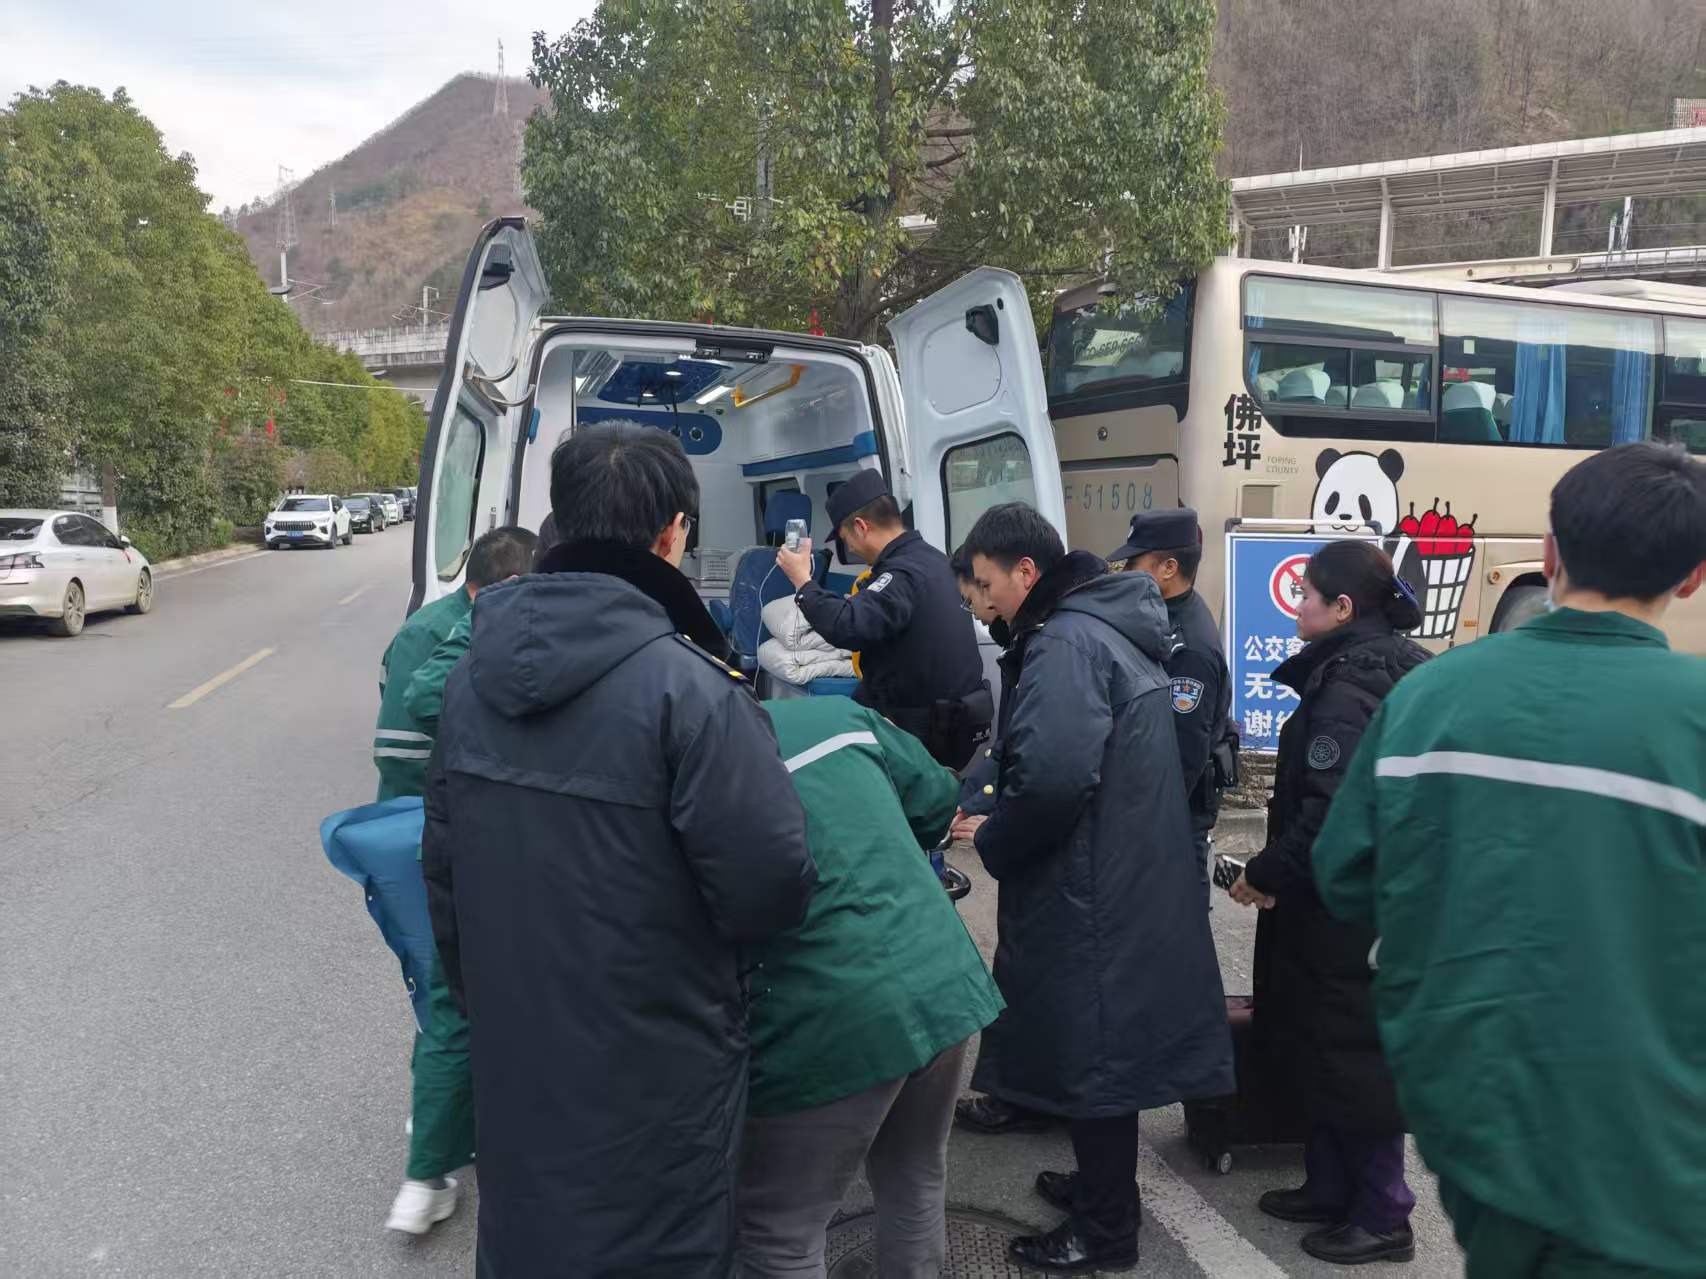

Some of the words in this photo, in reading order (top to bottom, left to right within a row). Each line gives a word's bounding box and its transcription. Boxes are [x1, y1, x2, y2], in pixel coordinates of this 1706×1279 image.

[1223, 393, 1262, 470] 佛坪
[1244, 635, 1311, 662] 公交客
